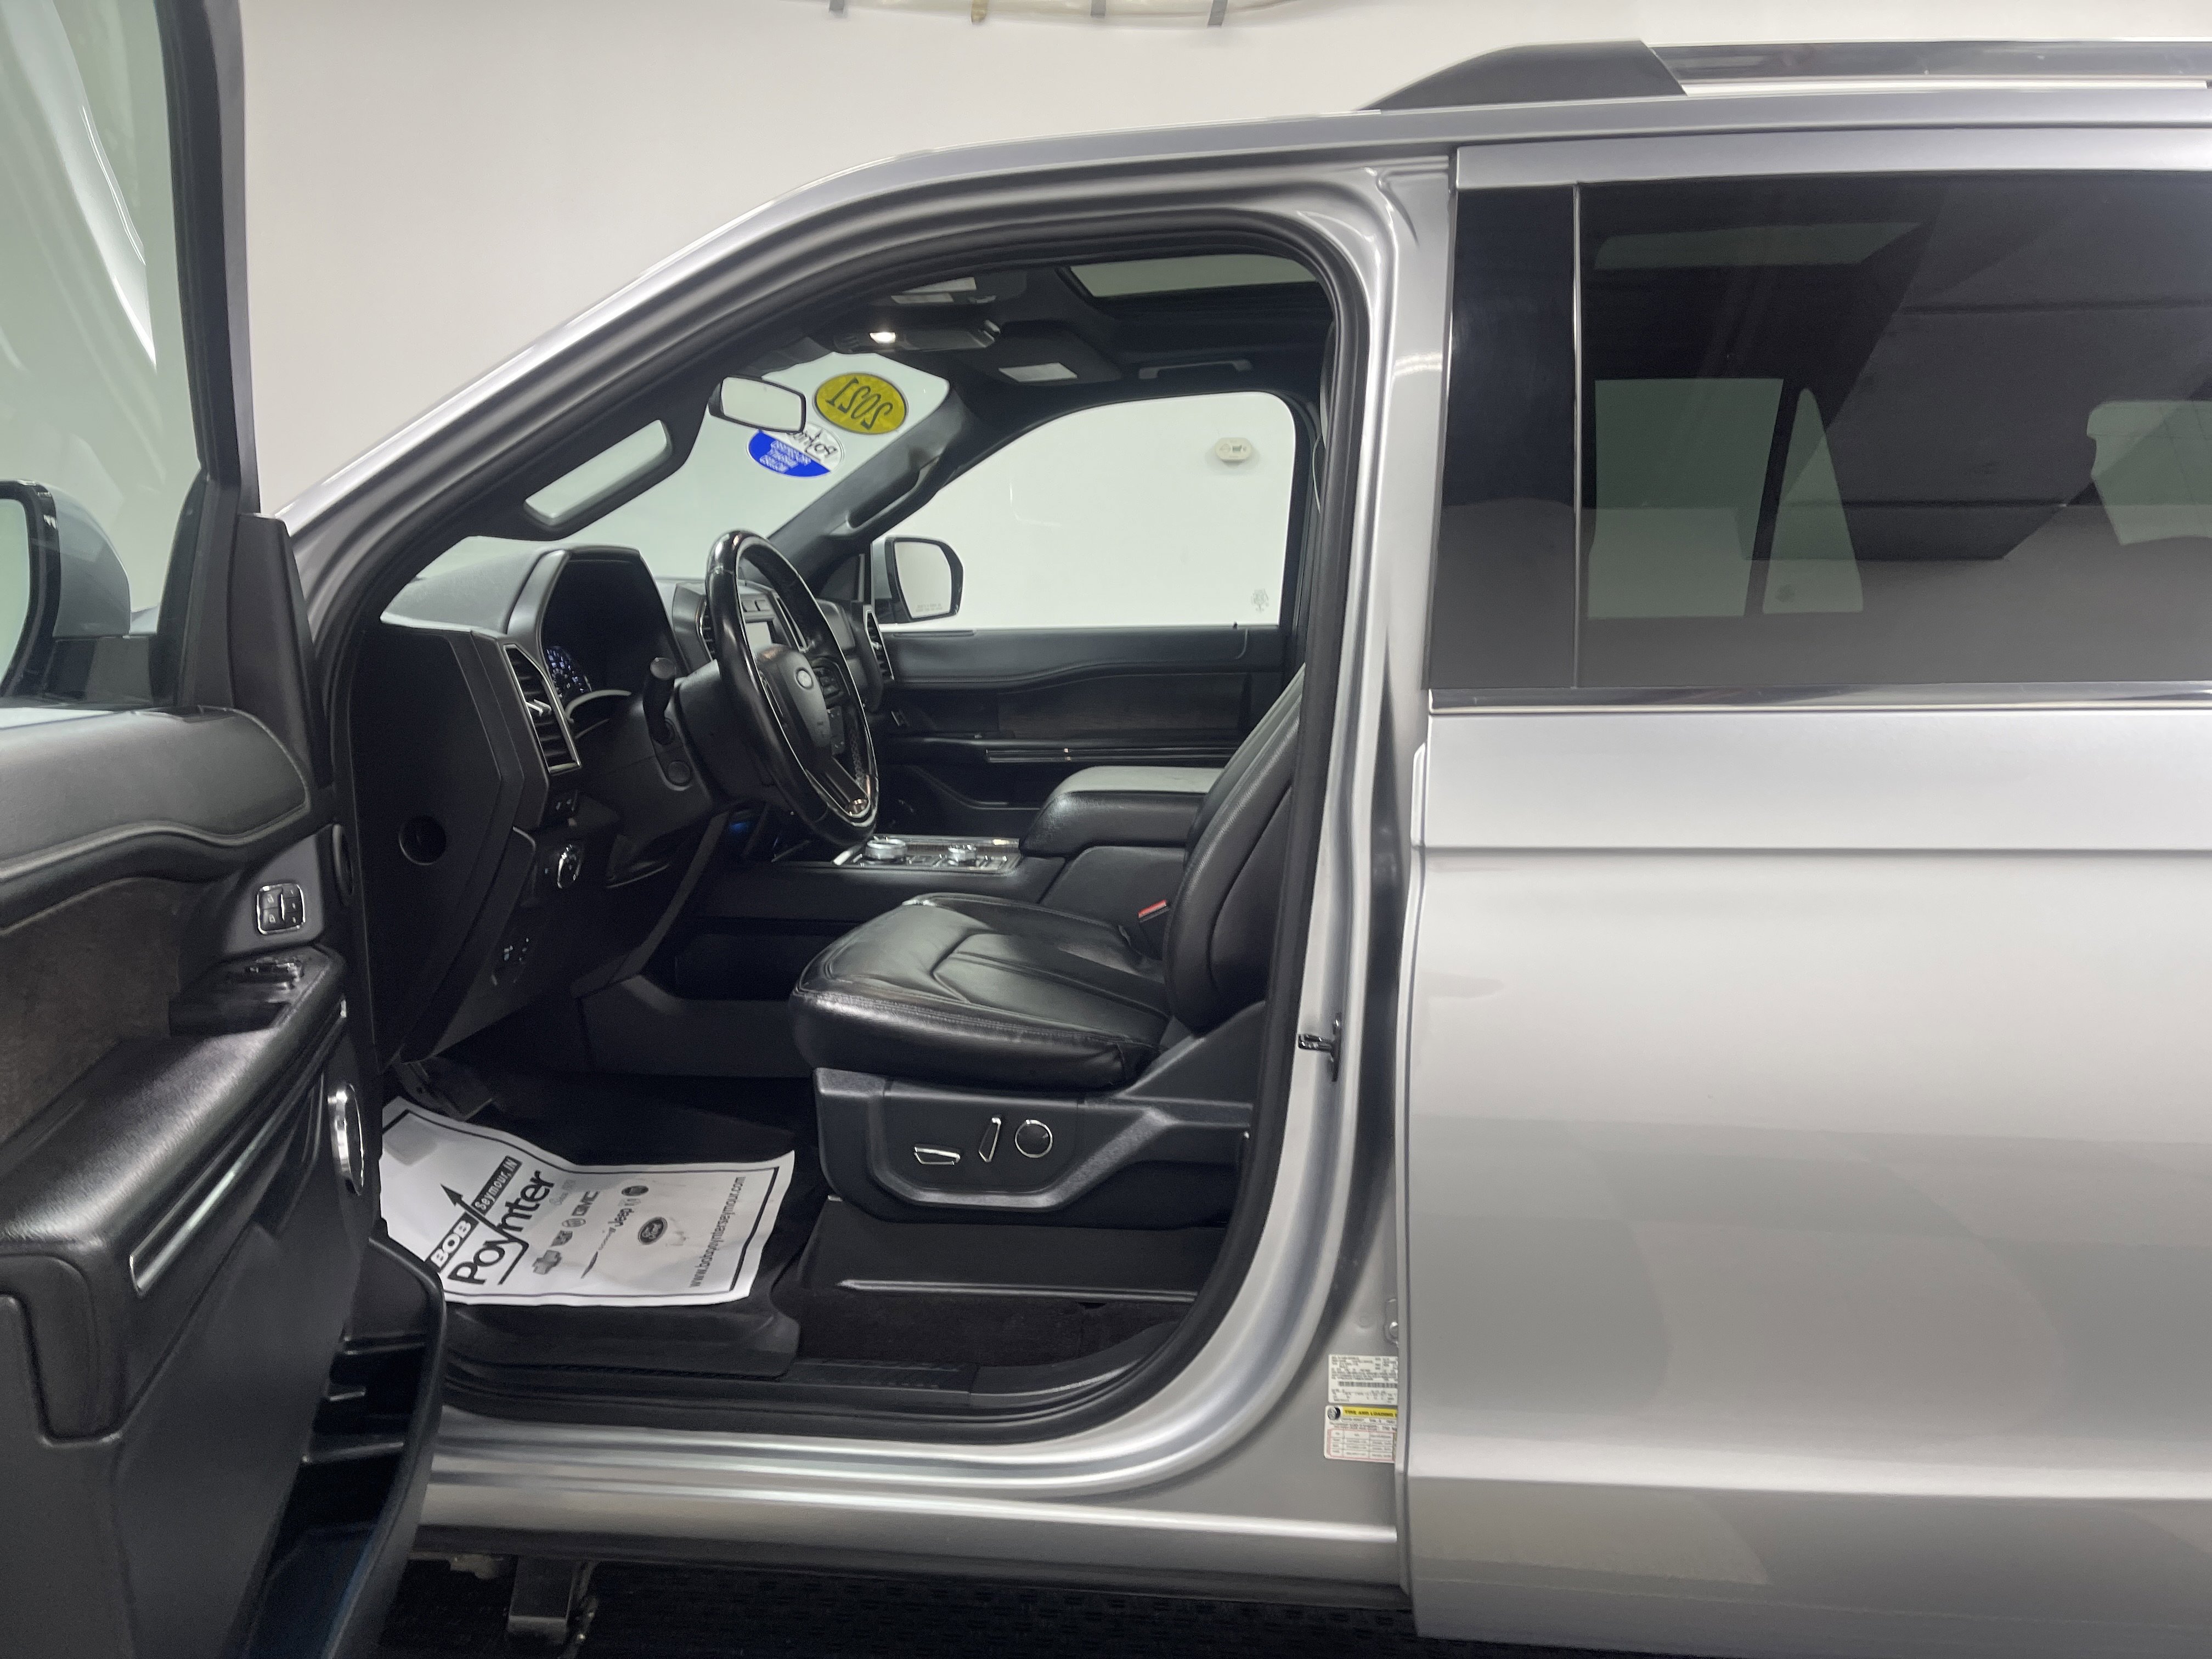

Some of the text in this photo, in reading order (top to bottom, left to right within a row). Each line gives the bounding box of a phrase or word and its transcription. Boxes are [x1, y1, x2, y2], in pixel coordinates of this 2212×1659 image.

[475, 1158, 517, 1211] Seymour, IN
[571, 1190, 600, 1216] GMC
[447, 1170, 555, 1285] Poynter
[608, 1208, 634, 1227] Jeep
[689, 1177, 747, 1288] www.bobpoynterseymour.com
[430, 1220, 471, 1268] BOB
